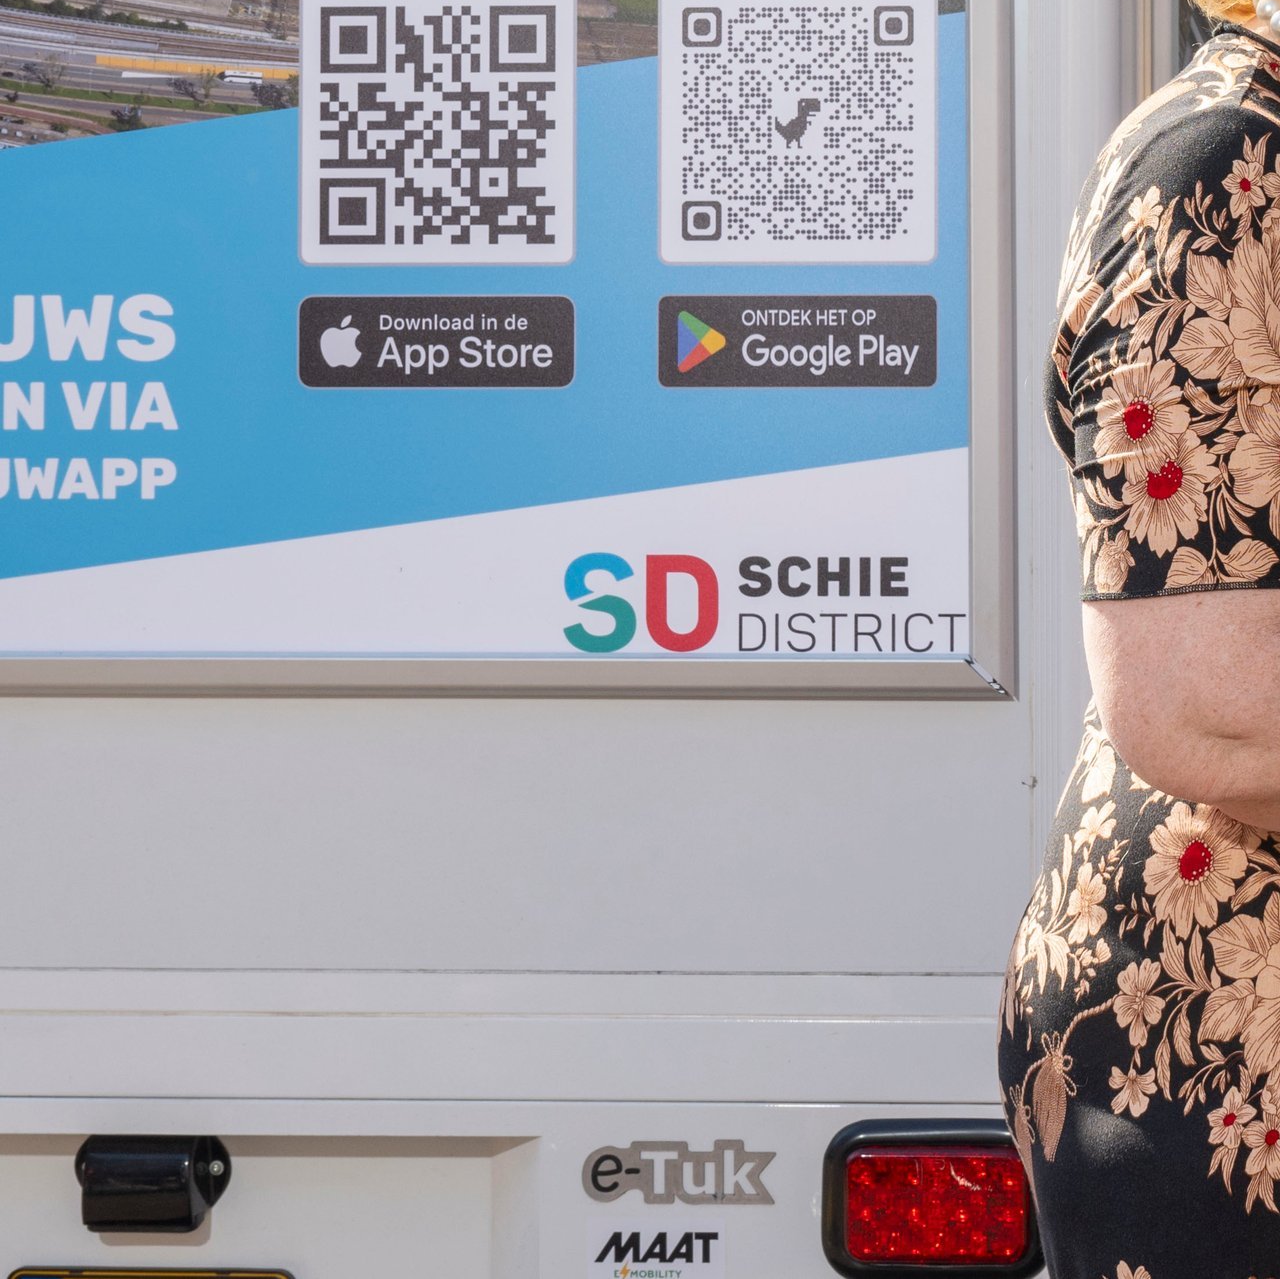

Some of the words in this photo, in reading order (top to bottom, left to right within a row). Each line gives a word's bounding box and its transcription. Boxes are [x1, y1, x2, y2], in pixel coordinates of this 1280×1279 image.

[379, 314, 474, 331] Download
[481, 314, 498, 331] in
[504, 314, 528, 331] de
[741, 309, 812, 326] ONTDEK
[816, 309, 848, 326] HET
[851, 309, 877, 326] OP
[376, 336, 450, 375] App
[458, 335, 553, 368] Store
[741, 333, 852, 376] Google
[859, 334, 920, 375] Play
[61, 381, 179, 430] VIA
[0, 458, 177, 500] WAPP
[738, 556, 910, 598] SCHIE
[563, 552, 719, 654] SD
[738, 612, 967, 653] DISTRICT
[591, 1149, 758, 1196] e-Tuk
[594, 1232, 719, 1263] MAAT
